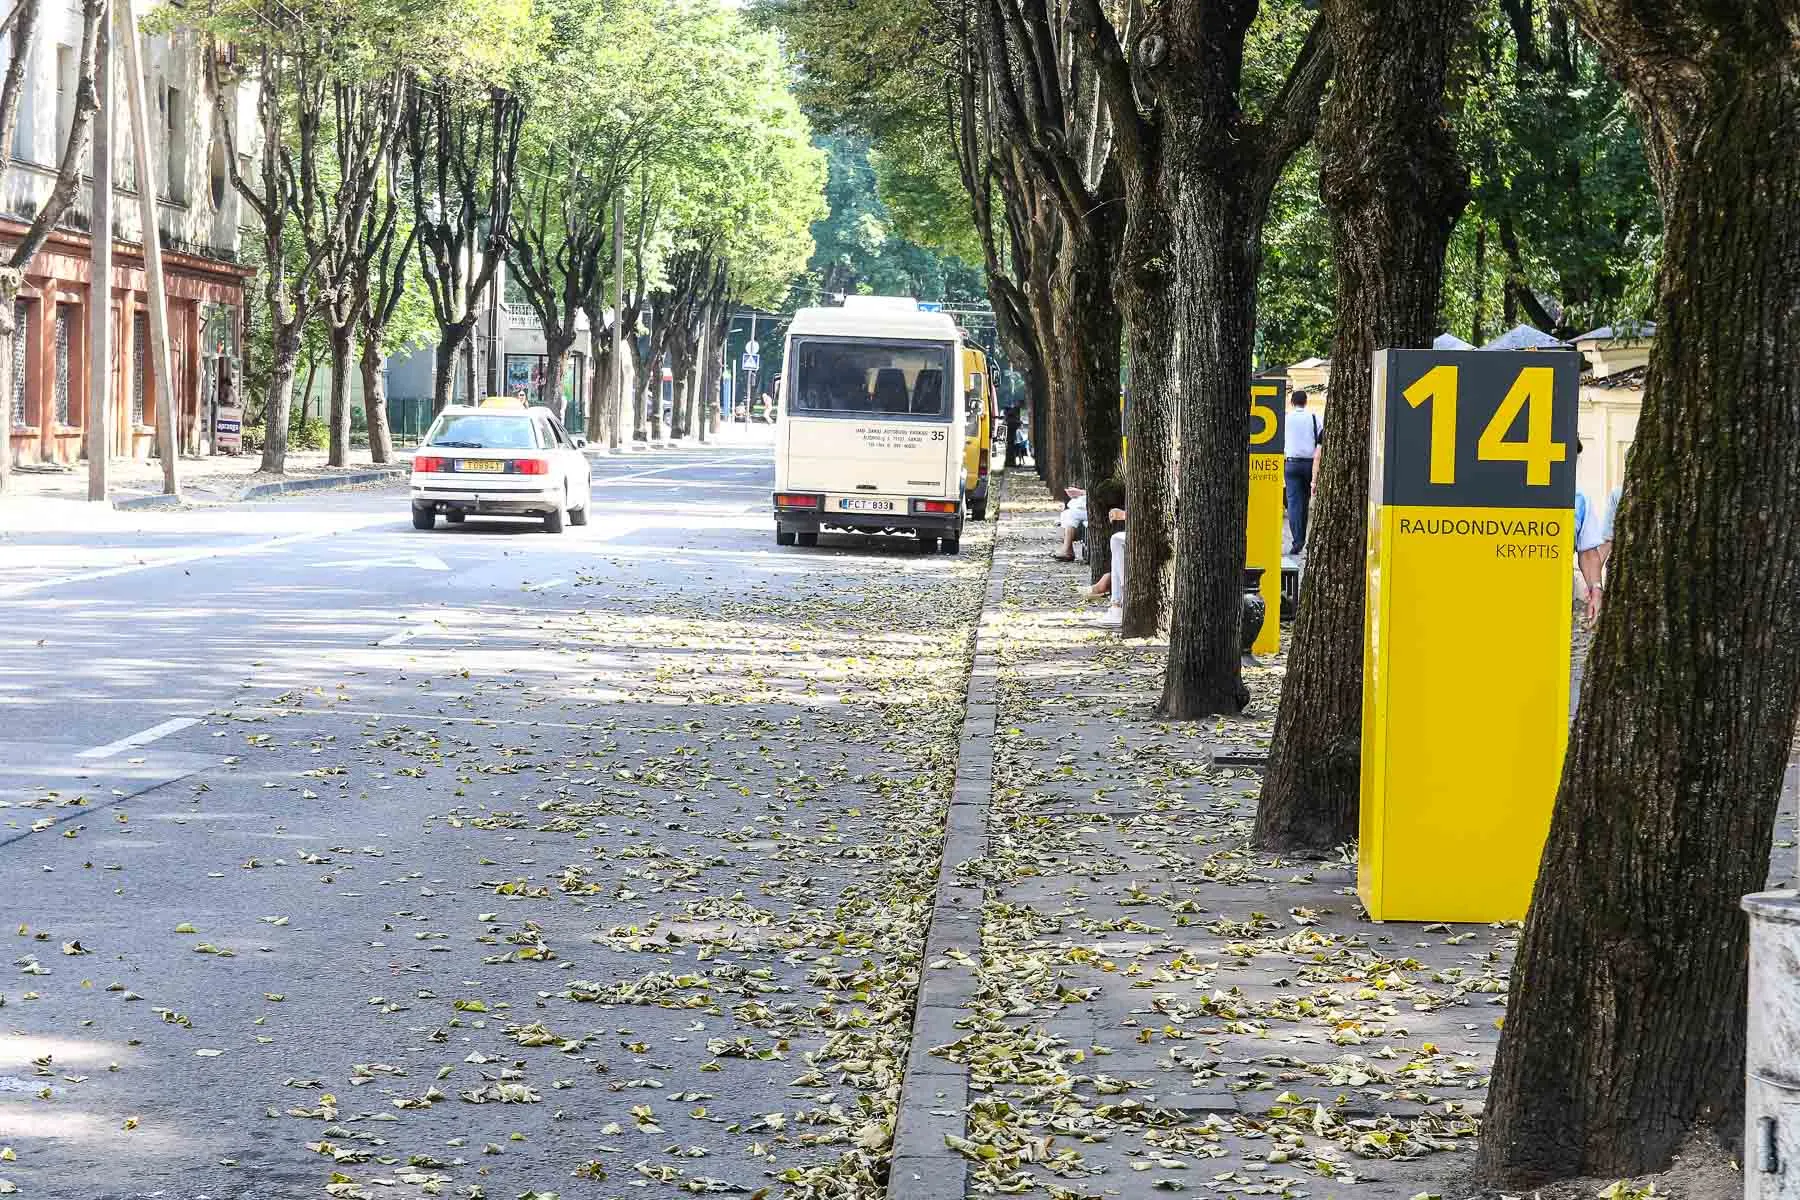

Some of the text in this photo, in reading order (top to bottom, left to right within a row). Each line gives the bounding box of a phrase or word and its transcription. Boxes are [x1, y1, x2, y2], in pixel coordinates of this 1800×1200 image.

[1401, 364, 1567, 487] 14
[931, 430, 945, 441] 35
[1251, 457, 1279, 471] INĖS
[848, 500, 889, 510] FCT 833
[1400, 518, 1561, 537] RAUDONDVARIO
[1496, 544, 1560, 559] KRYPTIS
